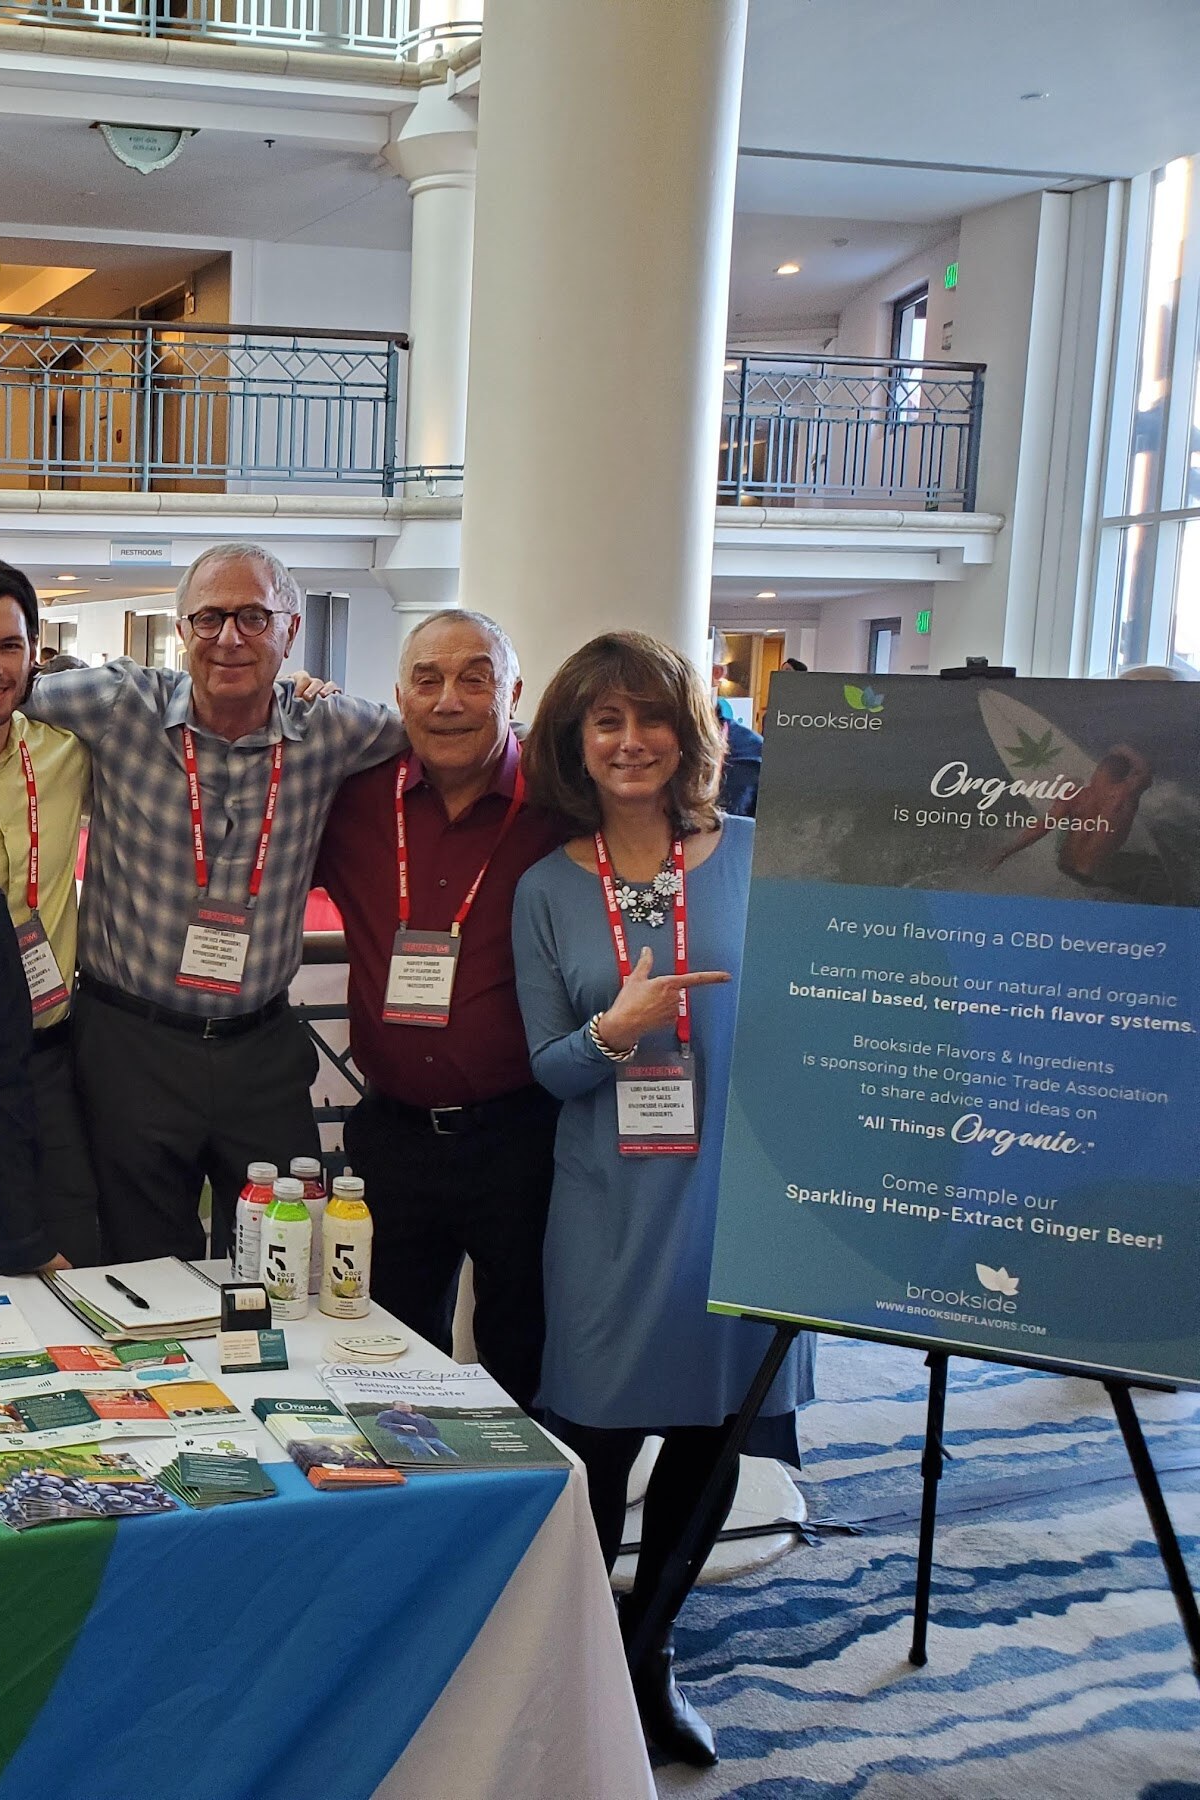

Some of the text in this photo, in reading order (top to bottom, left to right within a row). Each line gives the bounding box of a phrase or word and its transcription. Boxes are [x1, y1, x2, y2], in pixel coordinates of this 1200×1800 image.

[120, 548, 163, 557] RESTROOMS
[776, 709, 883, 732] brookside
[931, 762, 1083, 810] Organic
[894, 809, 1113, 832] is going to the beach.
[827, 918, 1166, 959] Are you flavoring a CBD beverage?
[811, 962, 1176, 1007] Learn more about our natural and organic
[790, 982, 1196, 1033] botanical based, terpene-rich flavor systems.
[854, 1035, 1114, 1073] Brookside Flavors & Ingredients
[803, 1055, 1168, 1103] is sponsoring the Organic Trade Association
[861, 1083, 1096, 1119] to share advice and ideas on
[890, 1119, 945, 1138] Things
[883, 1174, 1058, 1210] Come sample our
[786, 1184, 1162, 1249] Sparkling Hemp-Extract Ginger Beer!
[266, 1243, 287, 1283] 5
[331, 1243, 355, 1282] 5
[906, 1281, 1018, 1314] brookside
[875, 1299, 1047, 1336] WWW.BROOKSIDEFLAVORS.COM
[335, 1368, 483, 1383] ORGANIC Report
[354, 1381, 401, 1390] Nothing
[359, 1388, 420, 1397] everything
[274, 1401, 330, 1412] Organic
